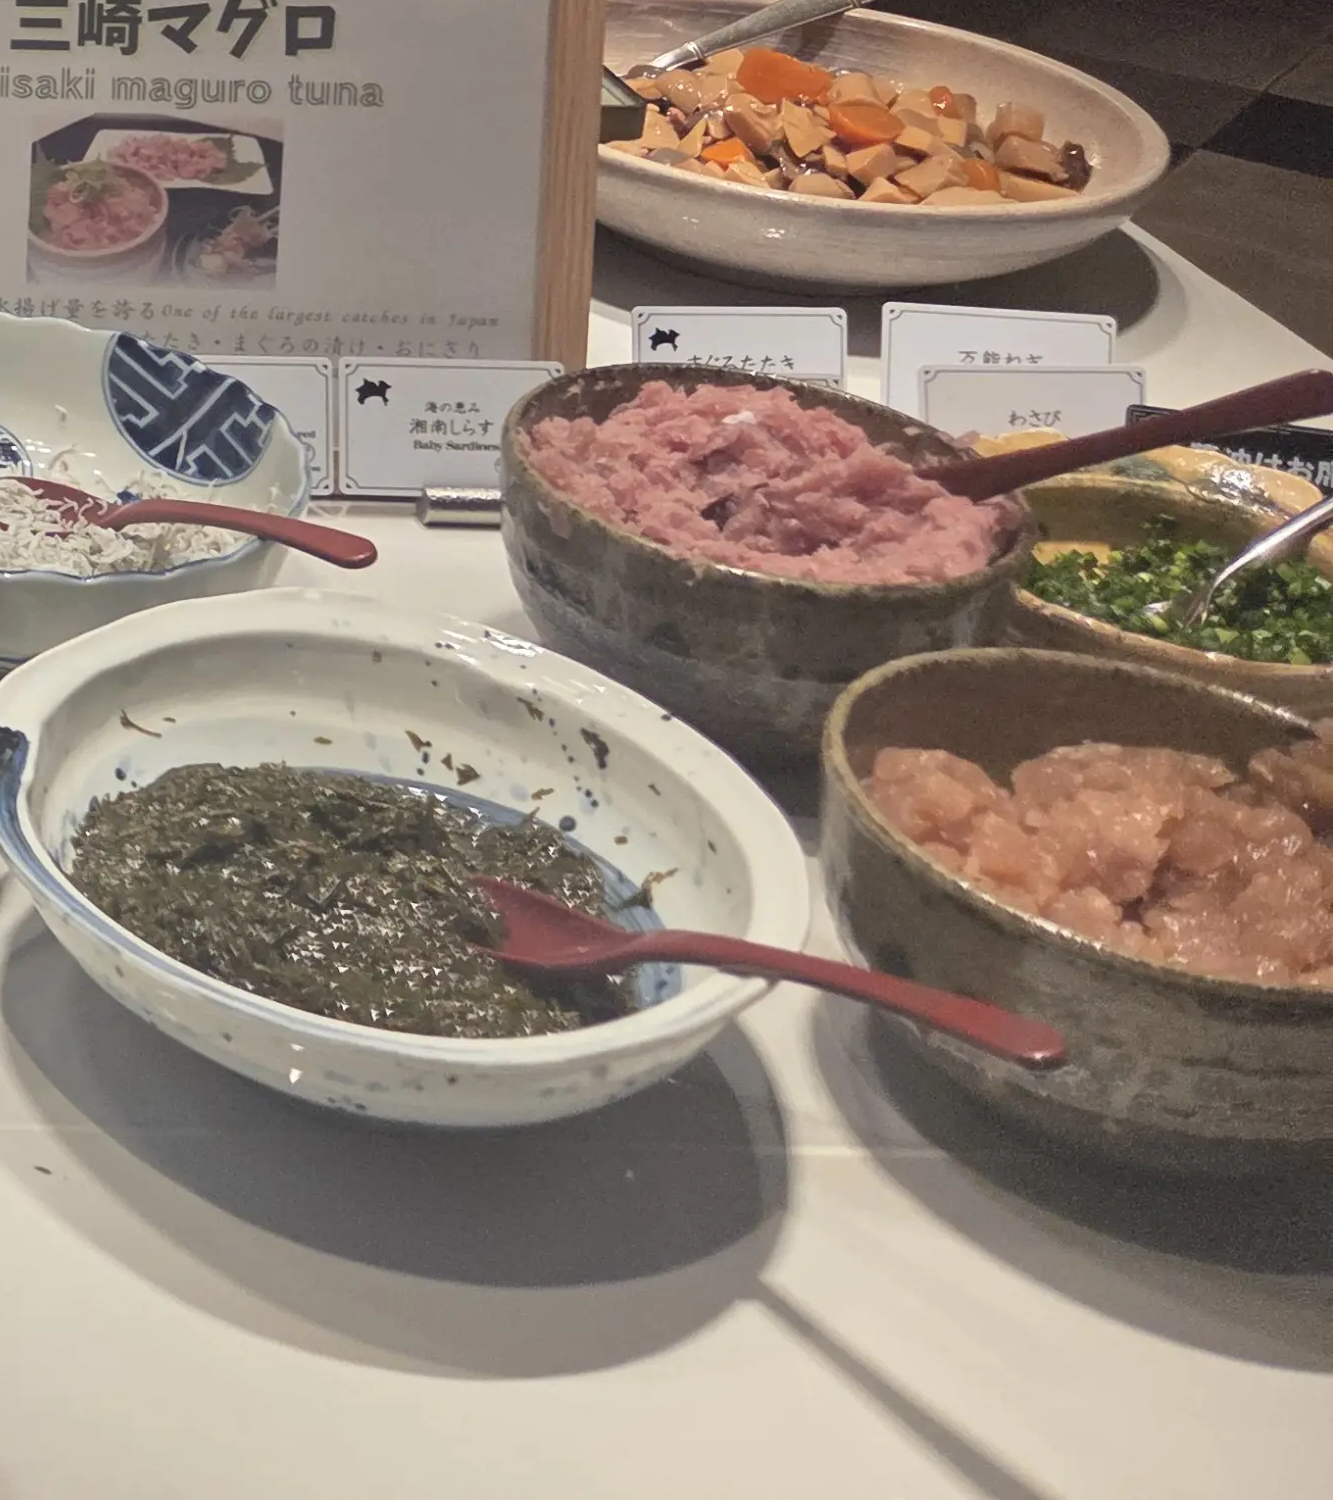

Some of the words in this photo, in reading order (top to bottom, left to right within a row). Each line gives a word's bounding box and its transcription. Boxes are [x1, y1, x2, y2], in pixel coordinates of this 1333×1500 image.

[110, 74, 272, 109] maguro
[288, 73, 384, 107] tuna
[268, 304, 331, 325] largest
[341, 309, 408, 324] catches
[408, 417, 494, 436] 湘南しらす
[1008, 409, 1061, 427] わさび
[413, 439, 442, 452] Baby
